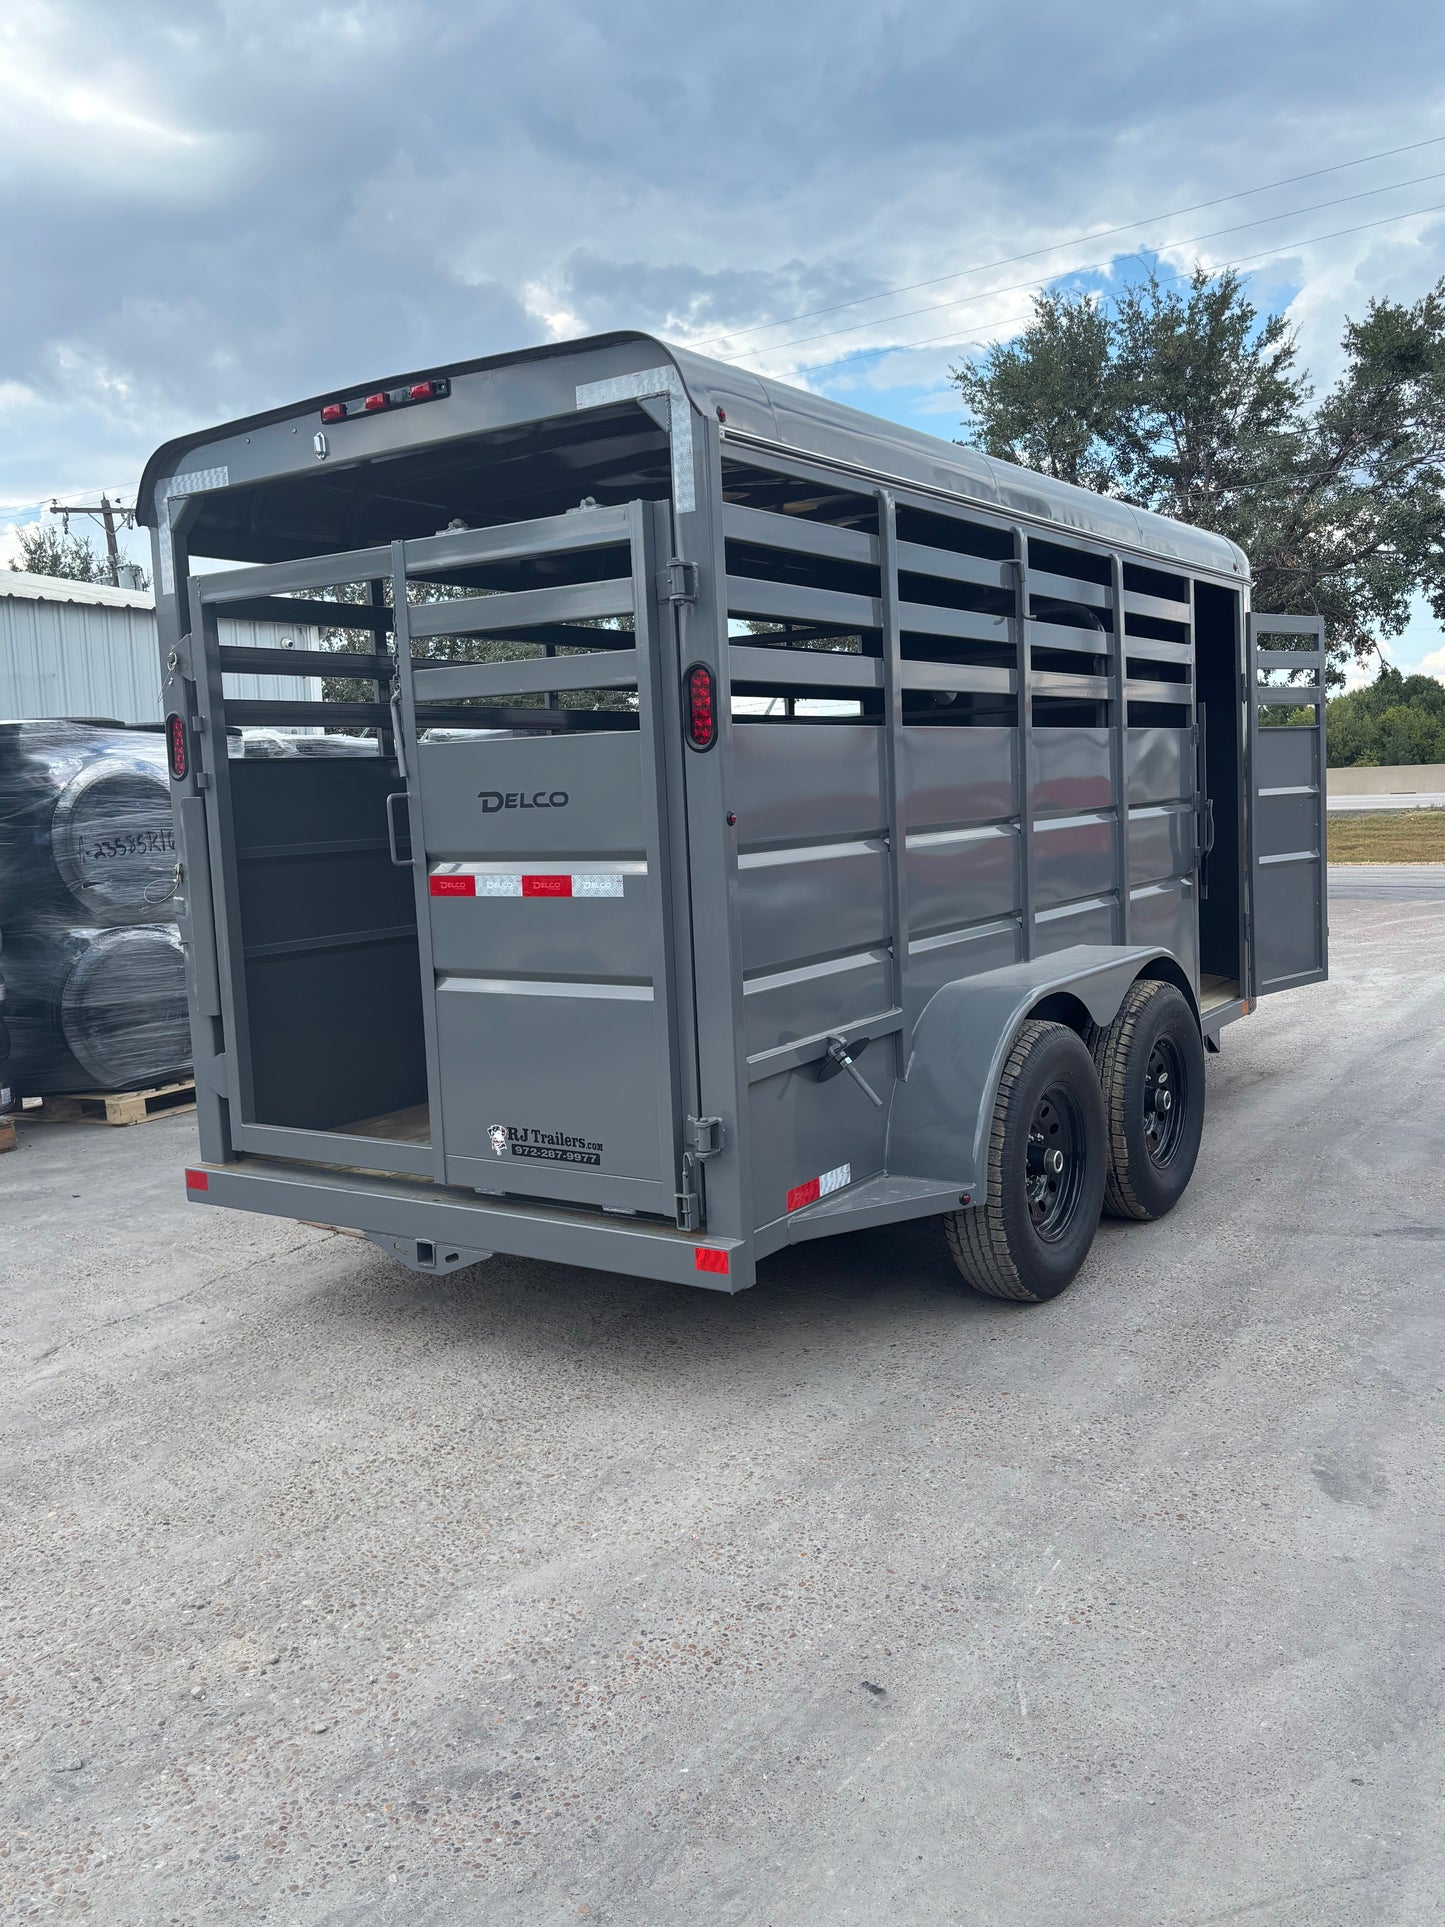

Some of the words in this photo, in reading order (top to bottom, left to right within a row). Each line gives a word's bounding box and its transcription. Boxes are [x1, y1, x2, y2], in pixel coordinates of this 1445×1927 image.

[477, 791, 569, 813] DELCO
[507, 1126, 529, 1142] RJ
[515, 1145, 597, 1163] 972-287-9977
